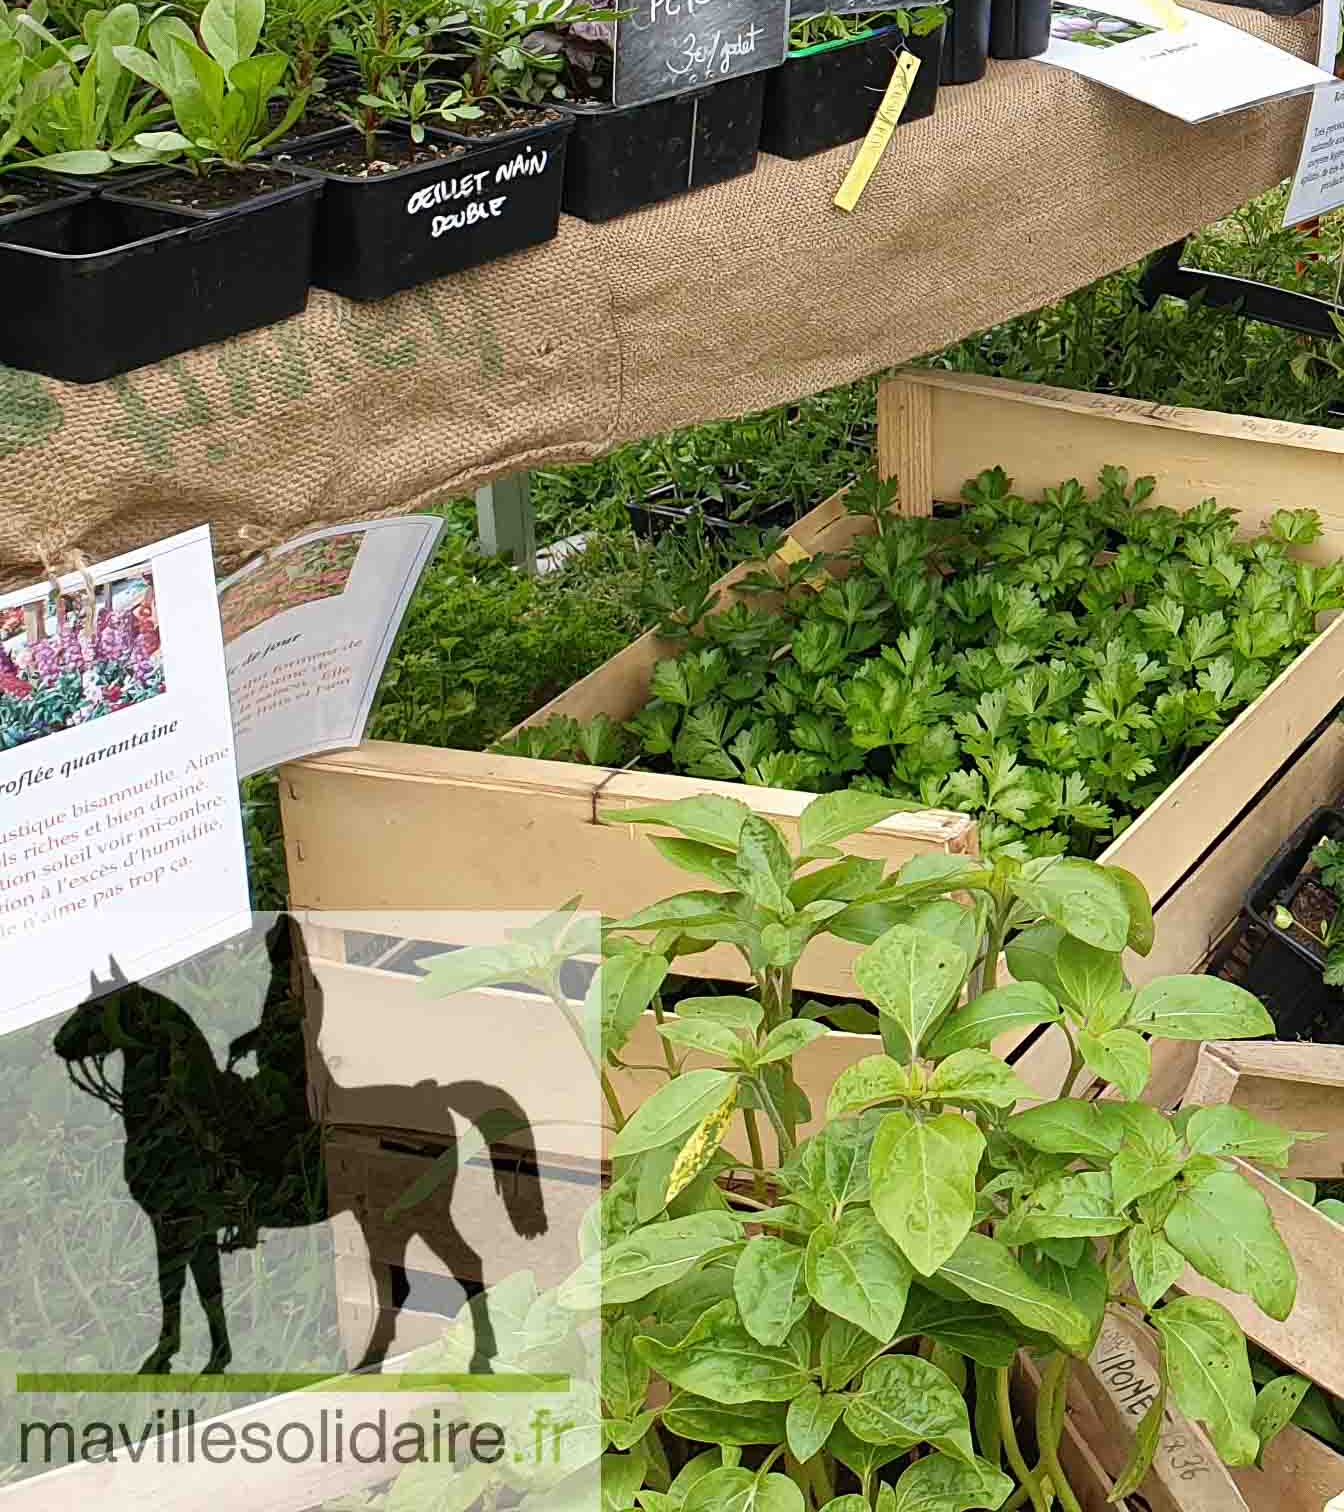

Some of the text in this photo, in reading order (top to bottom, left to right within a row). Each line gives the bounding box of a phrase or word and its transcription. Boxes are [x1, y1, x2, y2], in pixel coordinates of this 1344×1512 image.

[431, 195, 508, 238] DOUBLE
[60, 719, 179, 779] quarantaine
[184, 746, 231, 776] Aime
[23, 830, 80, 861] riches
[84, 822, 102, 838] et
[106, 802, 146, 830] bien
[42, 844, 93, 875] soleil
[96, 827, 135, 855] voir
[92, 885, 125, 909] pas
[128, 863, 166, 891] trop
